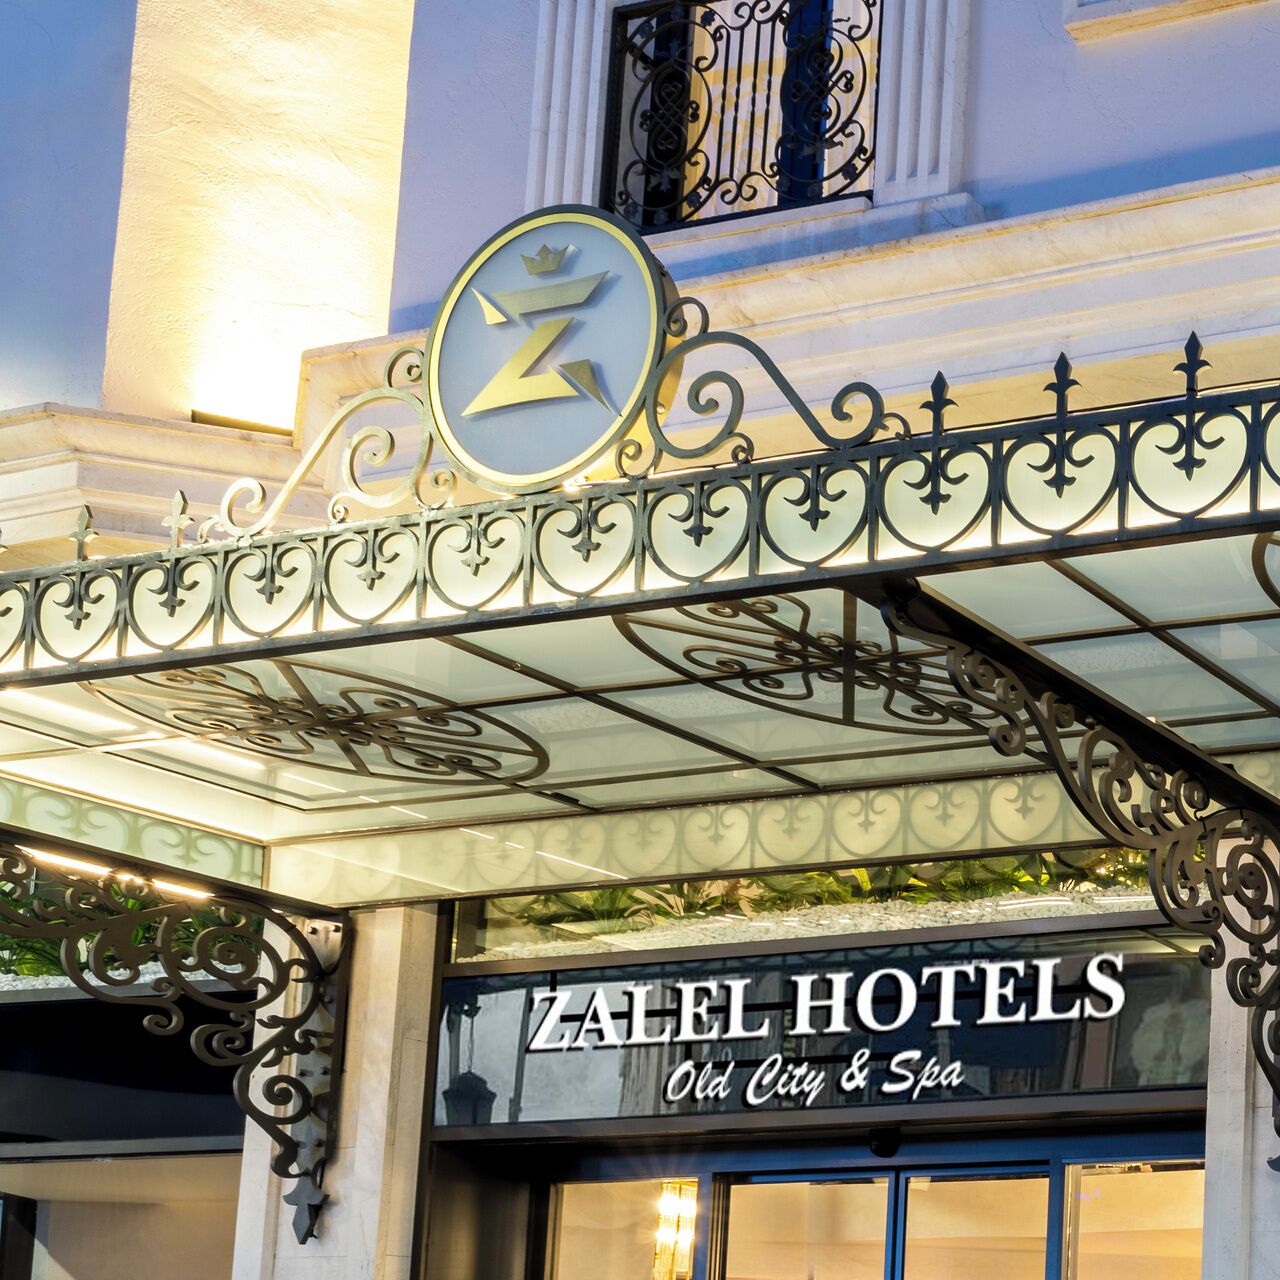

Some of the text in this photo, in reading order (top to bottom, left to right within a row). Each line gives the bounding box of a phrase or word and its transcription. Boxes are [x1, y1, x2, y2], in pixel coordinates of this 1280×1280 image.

[528, 953, 1127, 1050] ZALEL HOTELS
[667, 1049, 963, 1106] Old City & Spa
